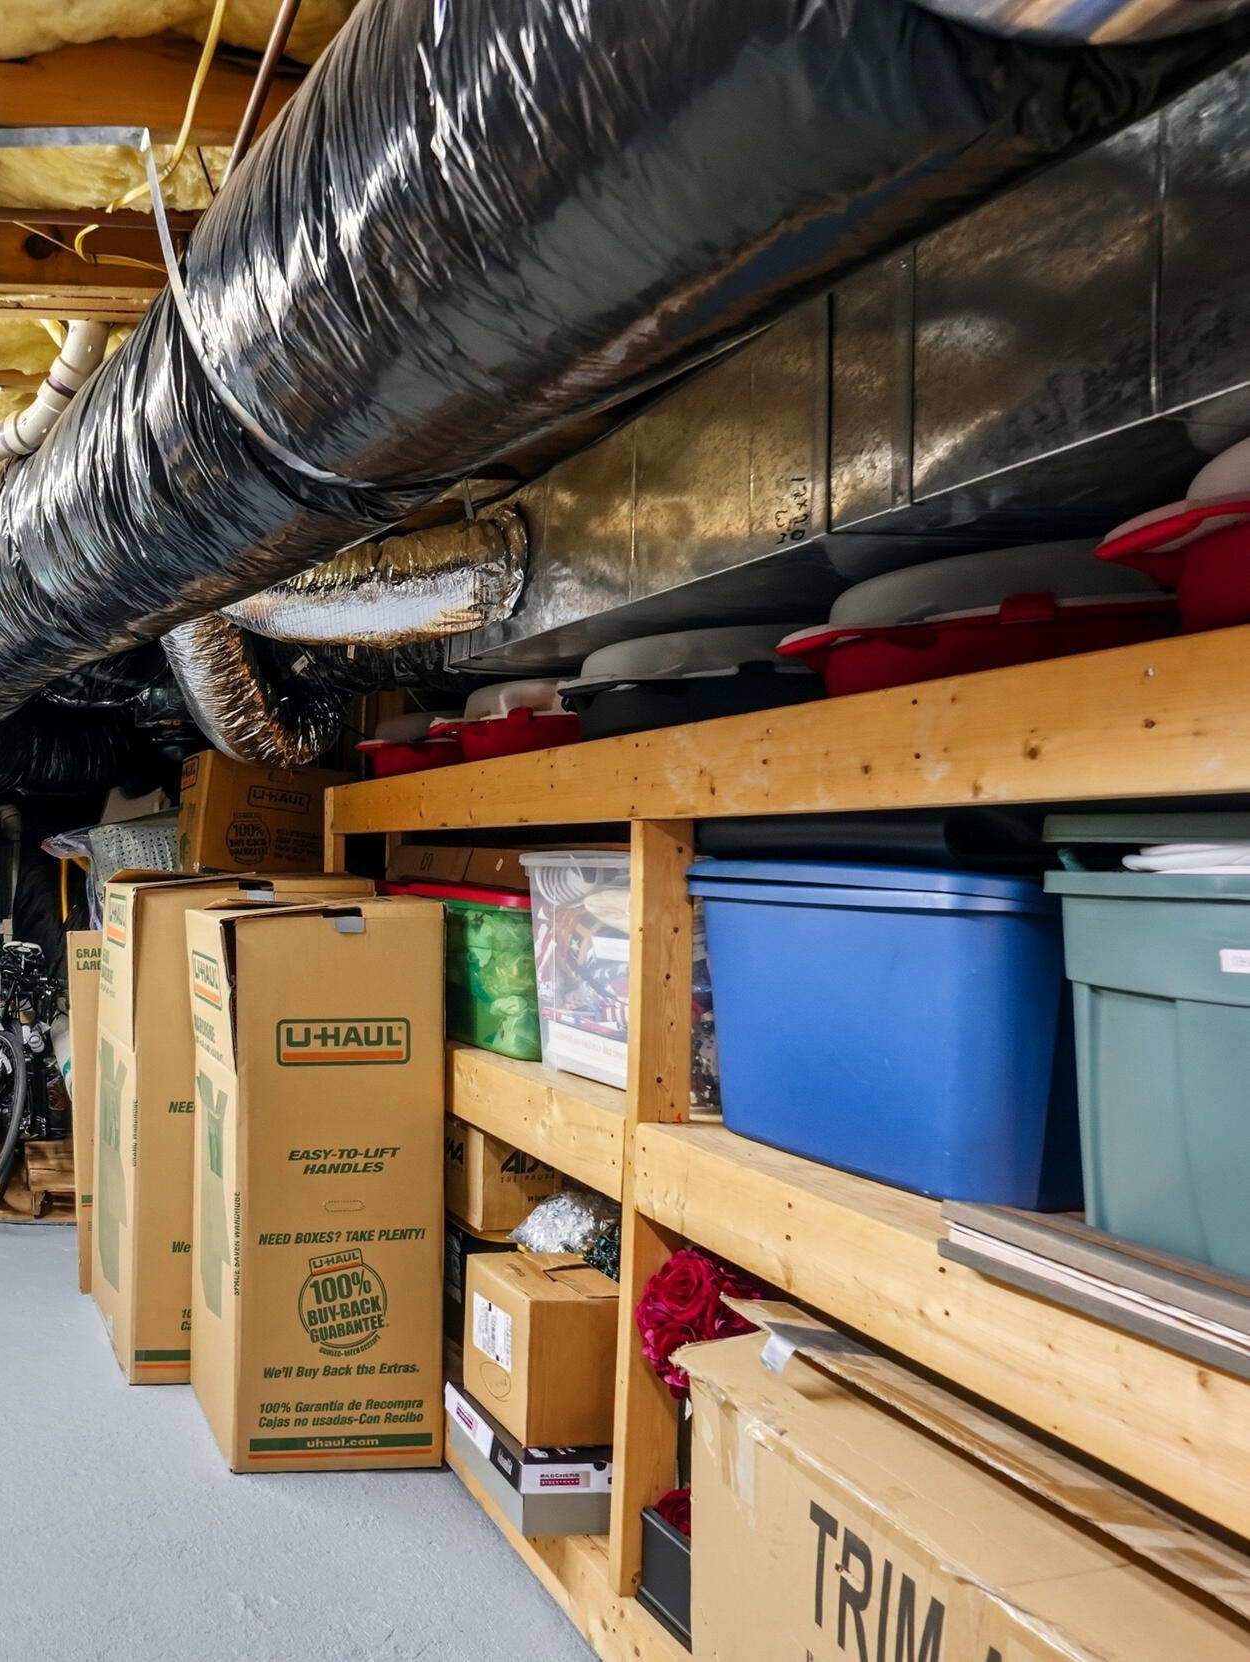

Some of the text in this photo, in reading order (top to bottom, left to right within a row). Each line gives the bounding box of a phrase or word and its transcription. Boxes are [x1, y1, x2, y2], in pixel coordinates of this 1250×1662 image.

[252, 788, 304, 805] U-HAUL
[286, 1025, 403, 1048] U-HAUL
[288, 1147, 401, 1161] EASY-TO-LIFT
[303, 1162, 385, 1175] HANDLES
[258, 1228, 426, 1245] NEED BOXES? TAKE PLENTY!
[312, 1252, 360, 1269] U-HAUL
[309, 1269, 372, 1305] 100%
[306, 1296, 382, 1327] BUY-BACK
[309, 1314, 386, 1344] GUARANTEE
[263, 1363, 420, 1379] We'll Buy Back the Extras.
[259, 1402, 291, 1414] 100%
[347, 1400, 362, 1411] de
[365, 1399, 424, 1411] Recompra
[258, 1411, 424, 1430] Cajas no usadas-Con Recibo
[306, 1438, 380, 1448] uhaul.com
[809, 1500, 945, 1662] TRIM
